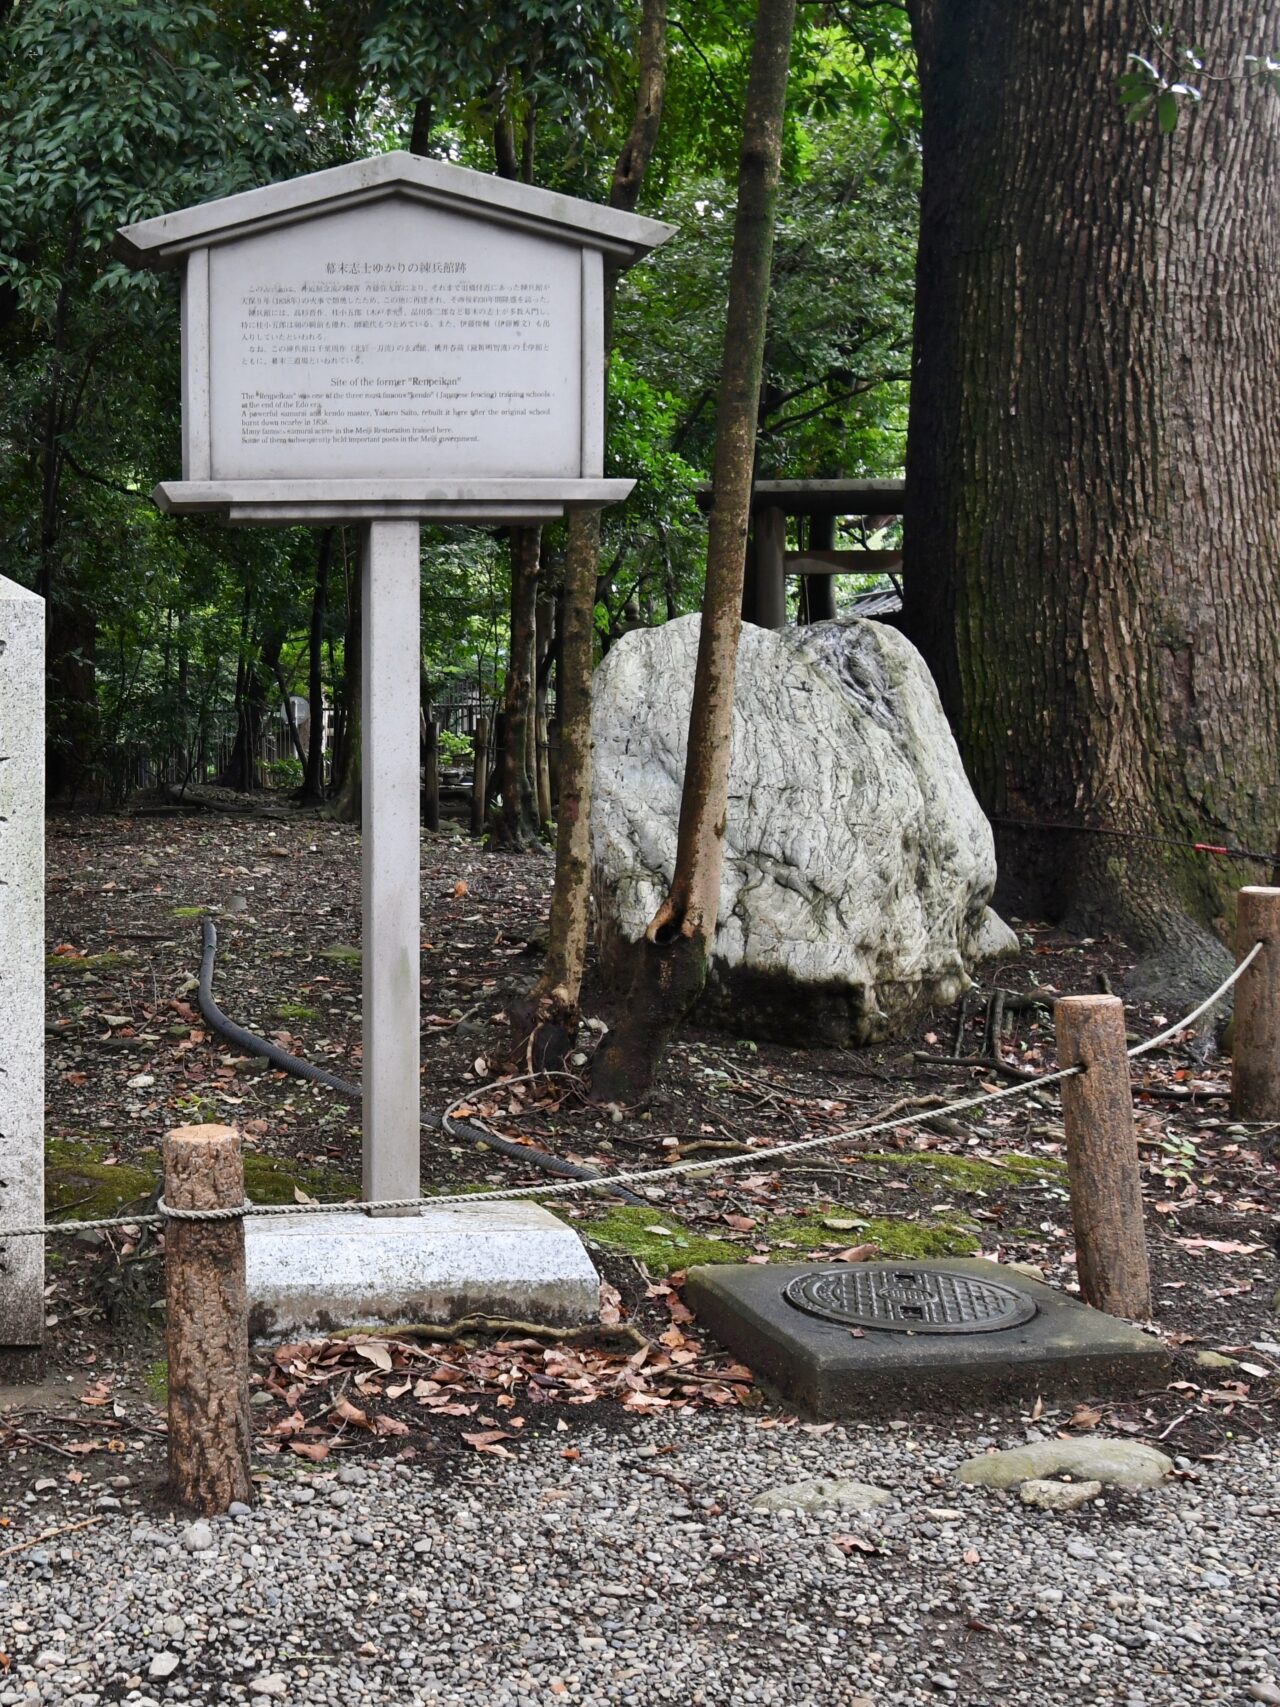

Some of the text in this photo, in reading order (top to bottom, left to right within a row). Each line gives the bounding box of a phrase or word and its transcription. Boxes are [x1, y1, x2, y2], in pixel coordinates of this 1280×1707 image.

[326, 261, 467, 275] 幕末志士ゆかりの練兵館跡
[331, 378, 347, 386] Site
[350, 378, 359, 386] of
[361, 378, 374, 386] the
[376, 378, 405, 386] former
[470, 392, 497, 400] fencing)
[498, 392, 524, 400] training
[249, 410, 278, 418] powerful
[501, 409, 526, 417] original
[280, 419, 302, 427] nearby
[242, 428, 260, 436] Many
[356, 427, 372, 435] Meiji
[348, 436, 380, 444] important
[382, 436, 399, 444] posts
[420, 436, 437, 444] Meiji
